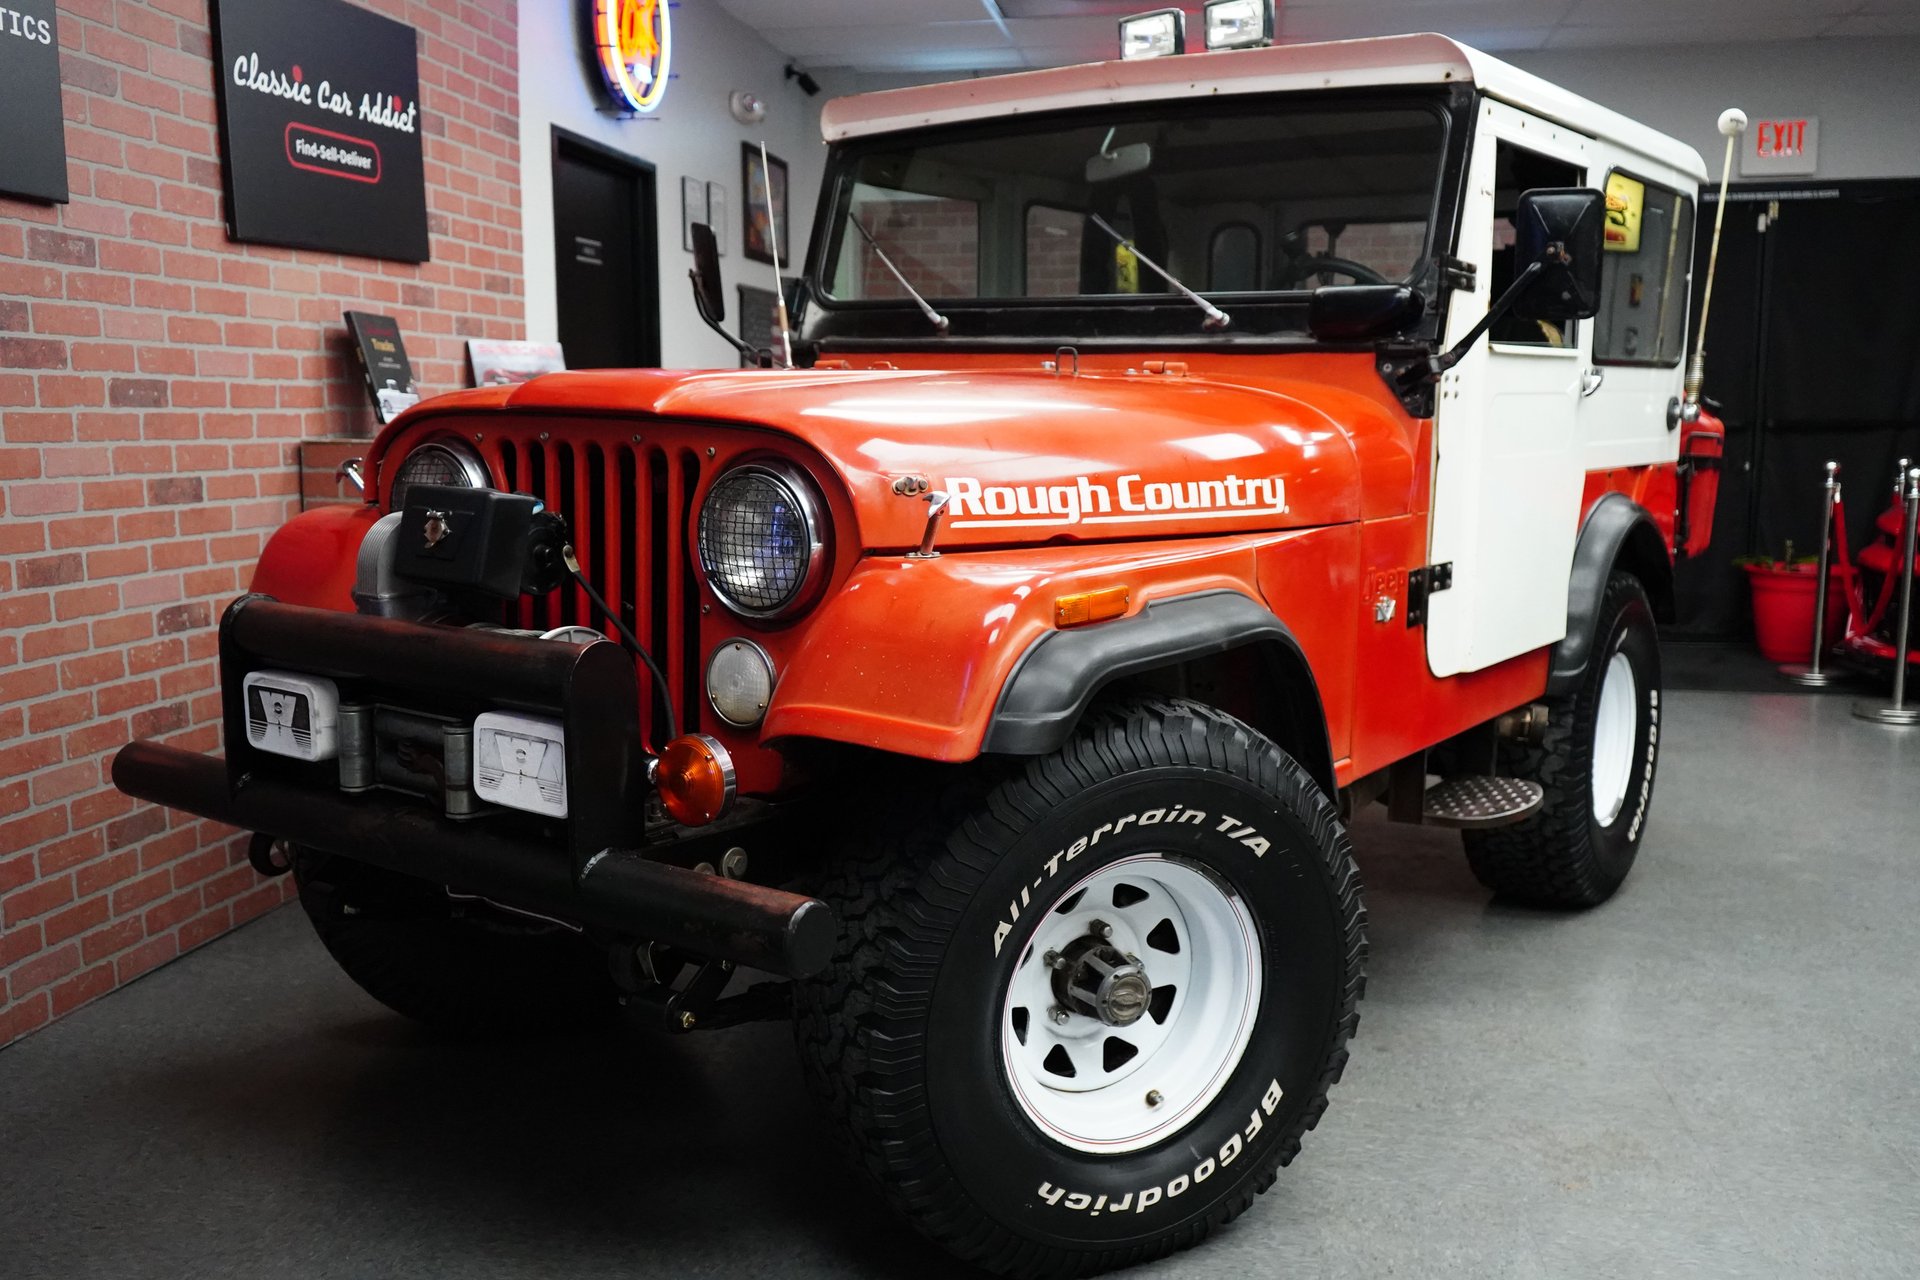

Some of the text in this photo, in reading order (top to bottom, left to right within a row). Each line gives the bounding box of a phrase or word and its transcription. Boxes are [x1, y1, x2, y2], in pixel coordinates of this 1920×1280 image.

[233, 52, 417, 133] Classic Car Addict
[296, 138, 373, 170] Find-Sell-Deliver
[1757, 119, 1808, 158] EXIT
[944, 476, 1111, 525] Rough
[994, 803, 1272, 958] All-Terrain T/A
[1037, 1077, 1284, 1217] BFGoodrich
